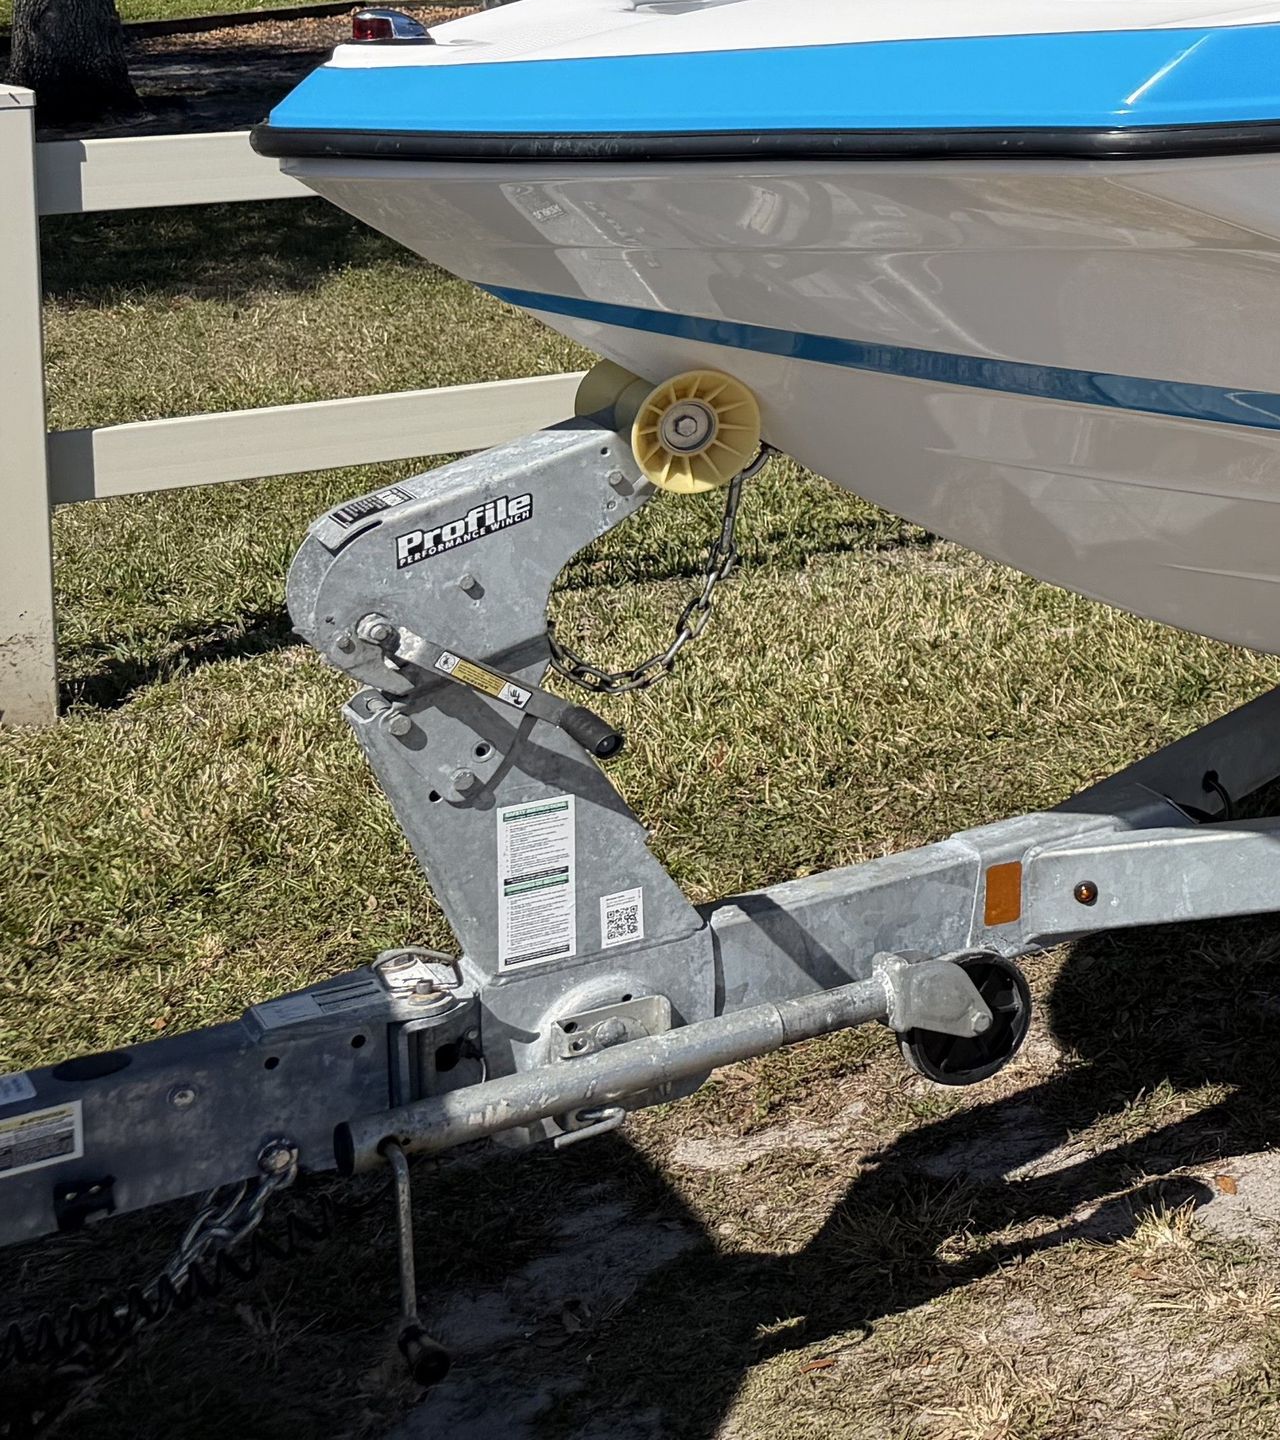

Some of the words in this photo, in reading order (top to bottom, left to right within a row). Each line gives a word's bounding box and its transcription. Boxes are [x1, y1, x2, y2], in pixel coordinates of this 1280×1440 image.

[397, 494, 531, 560] Profile
[399, 526, 486, 566] PERFORMANCE
[490, 510, 530, 532] WINCH
